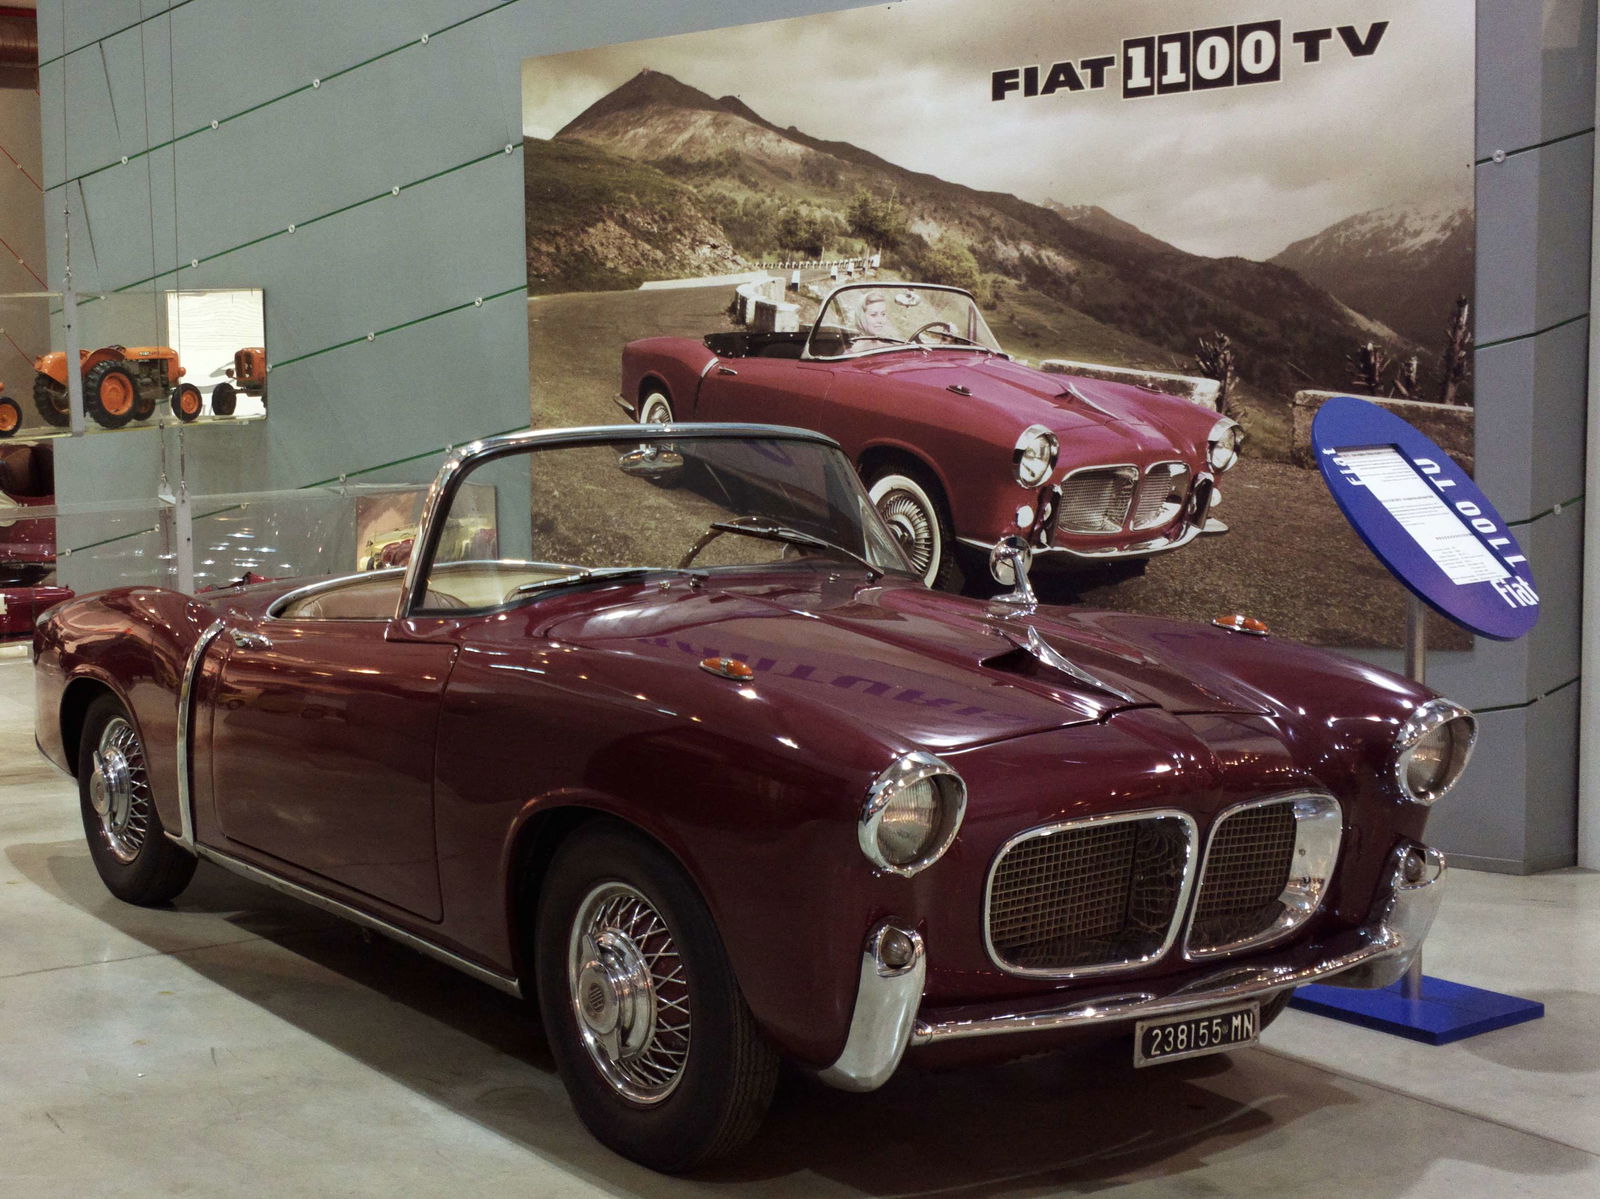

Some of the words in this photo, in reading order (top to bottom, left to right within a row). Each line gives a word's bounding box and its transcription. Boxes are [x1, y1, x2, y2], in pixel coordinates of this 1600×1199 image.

[992, 55, 1115, 101] FIAT
[1125, 27, 1279, 92] 1100
[1293, 21, 1389, 63] TV
[1456, 501, 1527, 568] 1100
[1490, 576, 1539, 608] Fiat
[1150, 1019, 1221, 1056] 238155
[1231, 1012, 1253, 1041] MN
